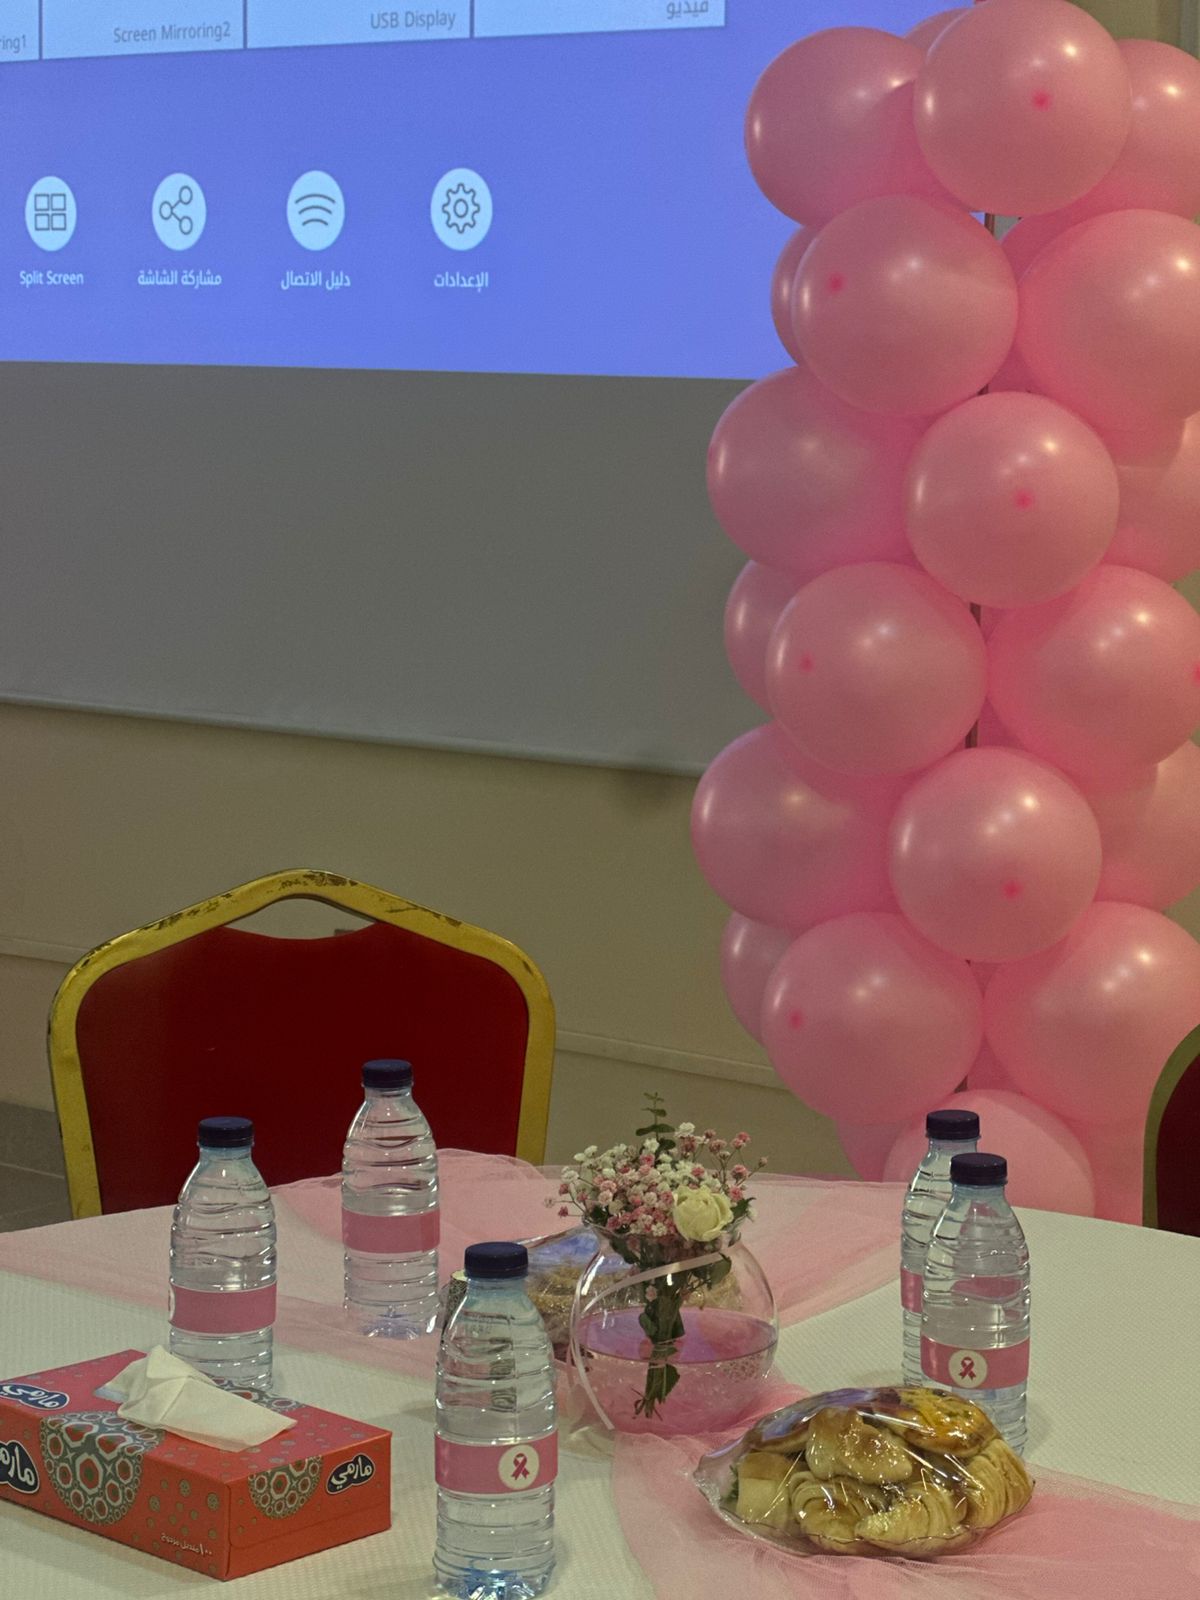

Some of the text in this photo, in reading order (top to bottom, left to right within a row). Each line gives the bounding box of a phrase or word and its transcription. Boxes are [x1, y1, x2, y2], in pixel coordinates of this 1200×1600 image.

[370, 11, 456, 30] USB Display
[112, 21, 231, 43] Screen Mirroring2
[19, 270, 84, 288] Split Screen
[137, 268, 222, 289] مشاركة الشاشة
[280, 270, 351, 290] دليل الاتصال
[433, 272, 489, 292] الإعدادات
